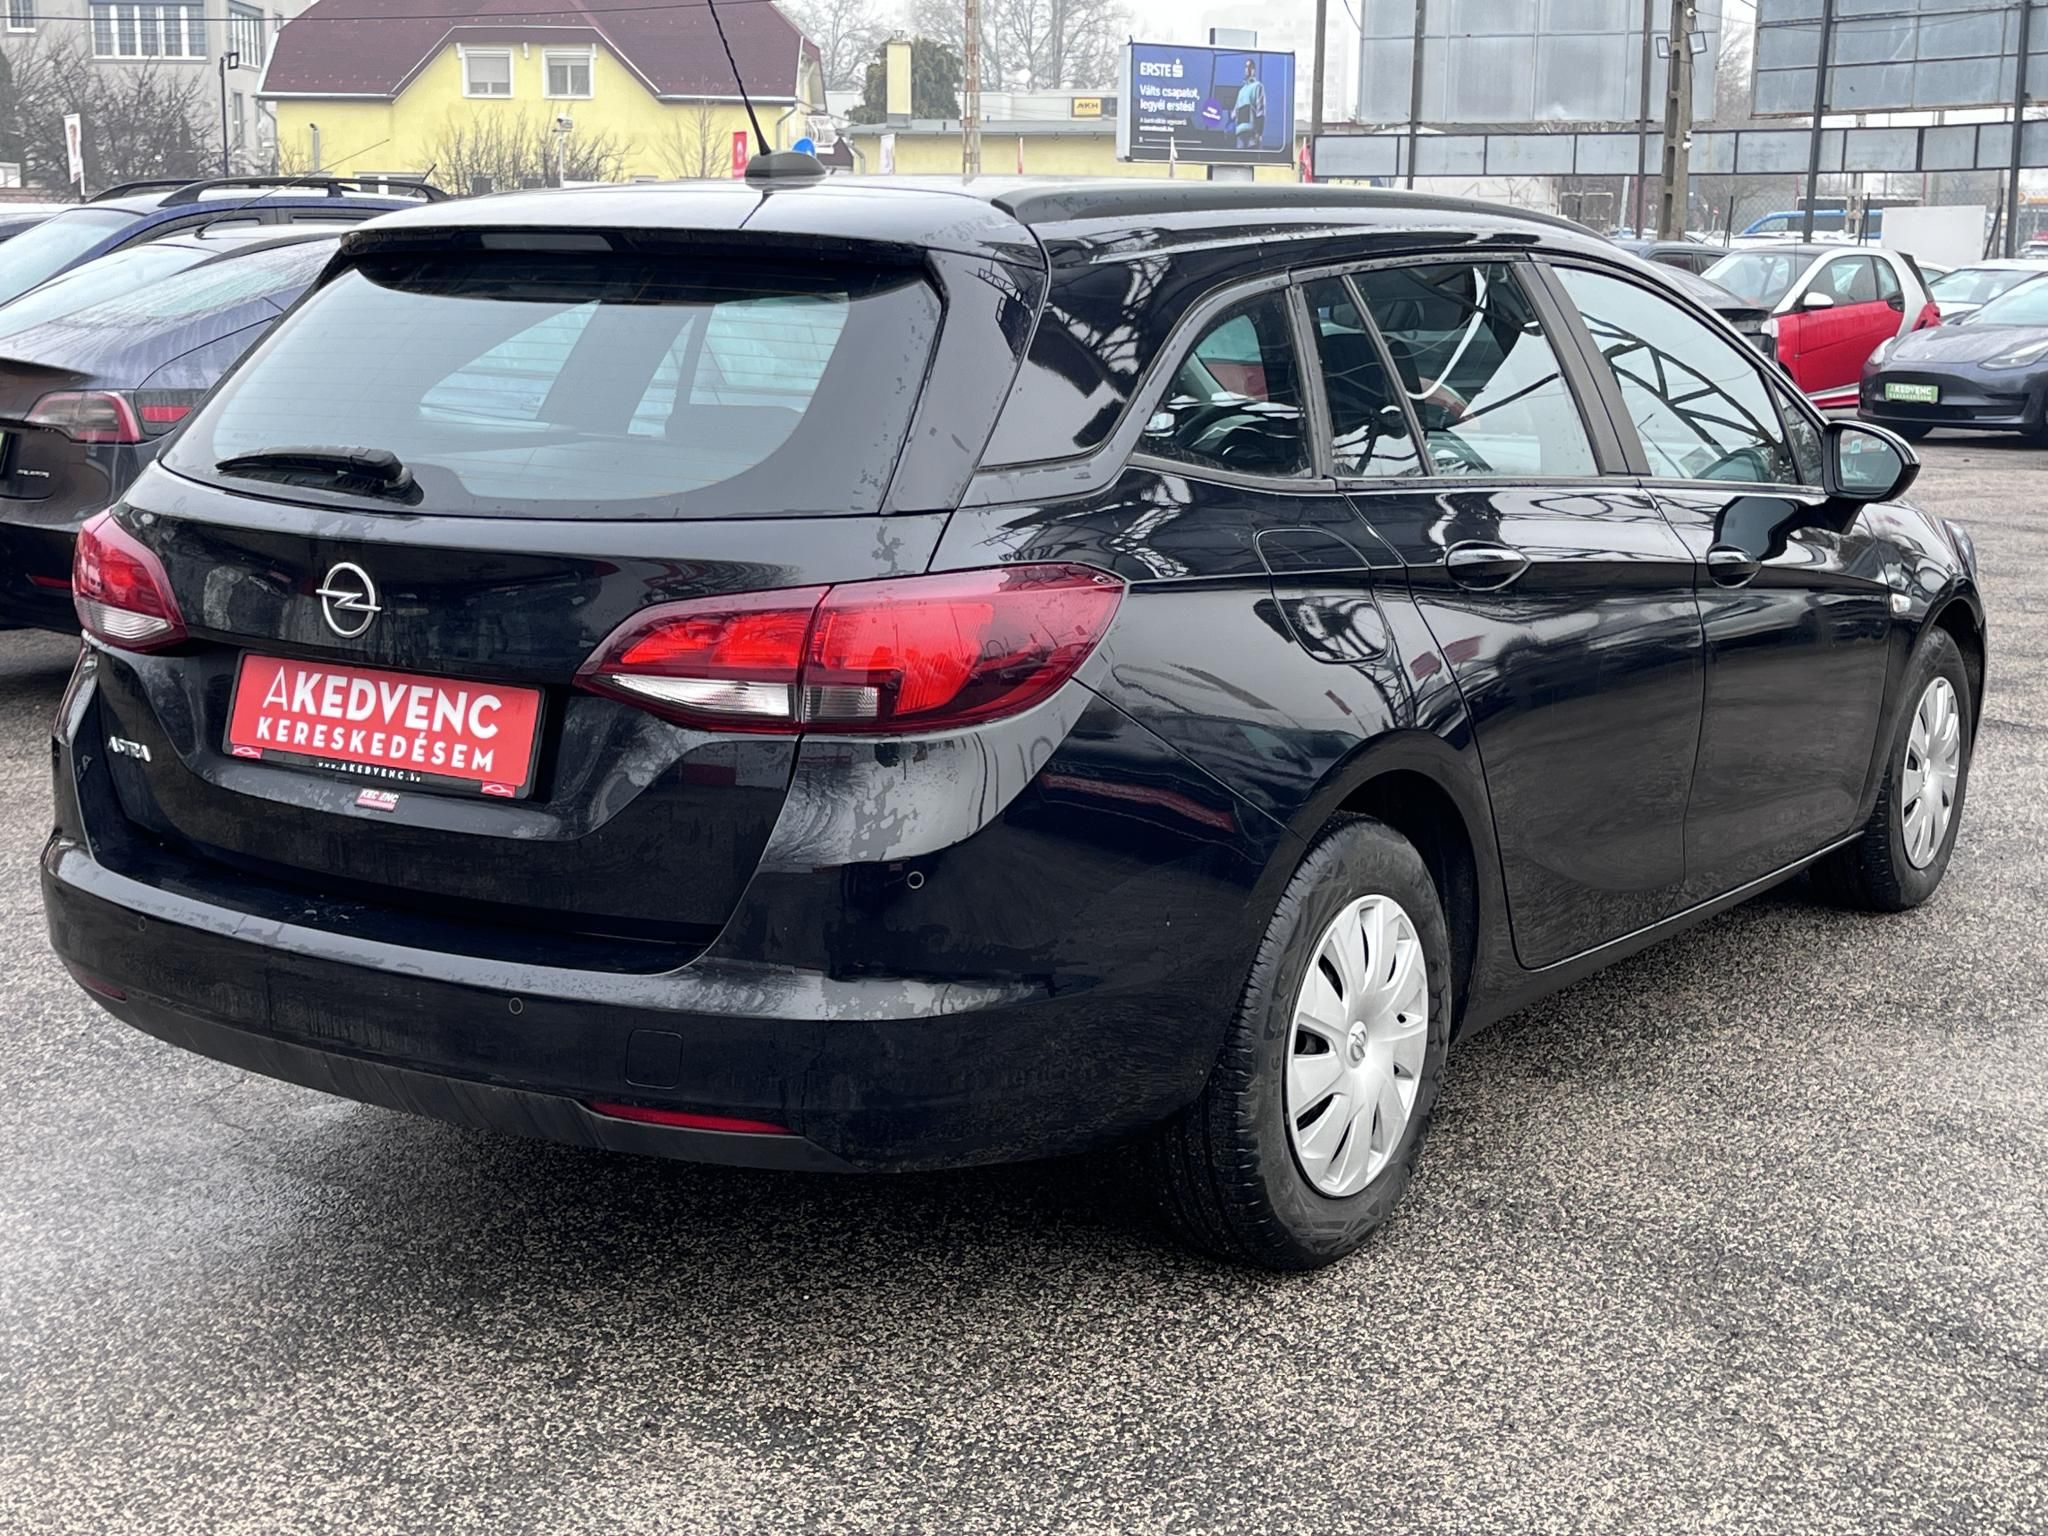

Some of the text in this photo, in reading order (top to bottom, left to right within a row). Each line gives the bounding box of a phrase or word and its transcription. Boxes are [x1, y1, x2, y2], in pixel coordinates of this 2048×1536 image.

[1140, 62, 1171, 77] ERSTE
[262, 664, 502, 740] AKEDVENC
[256, 716, 495, 773] KERESKEDÉSEM
